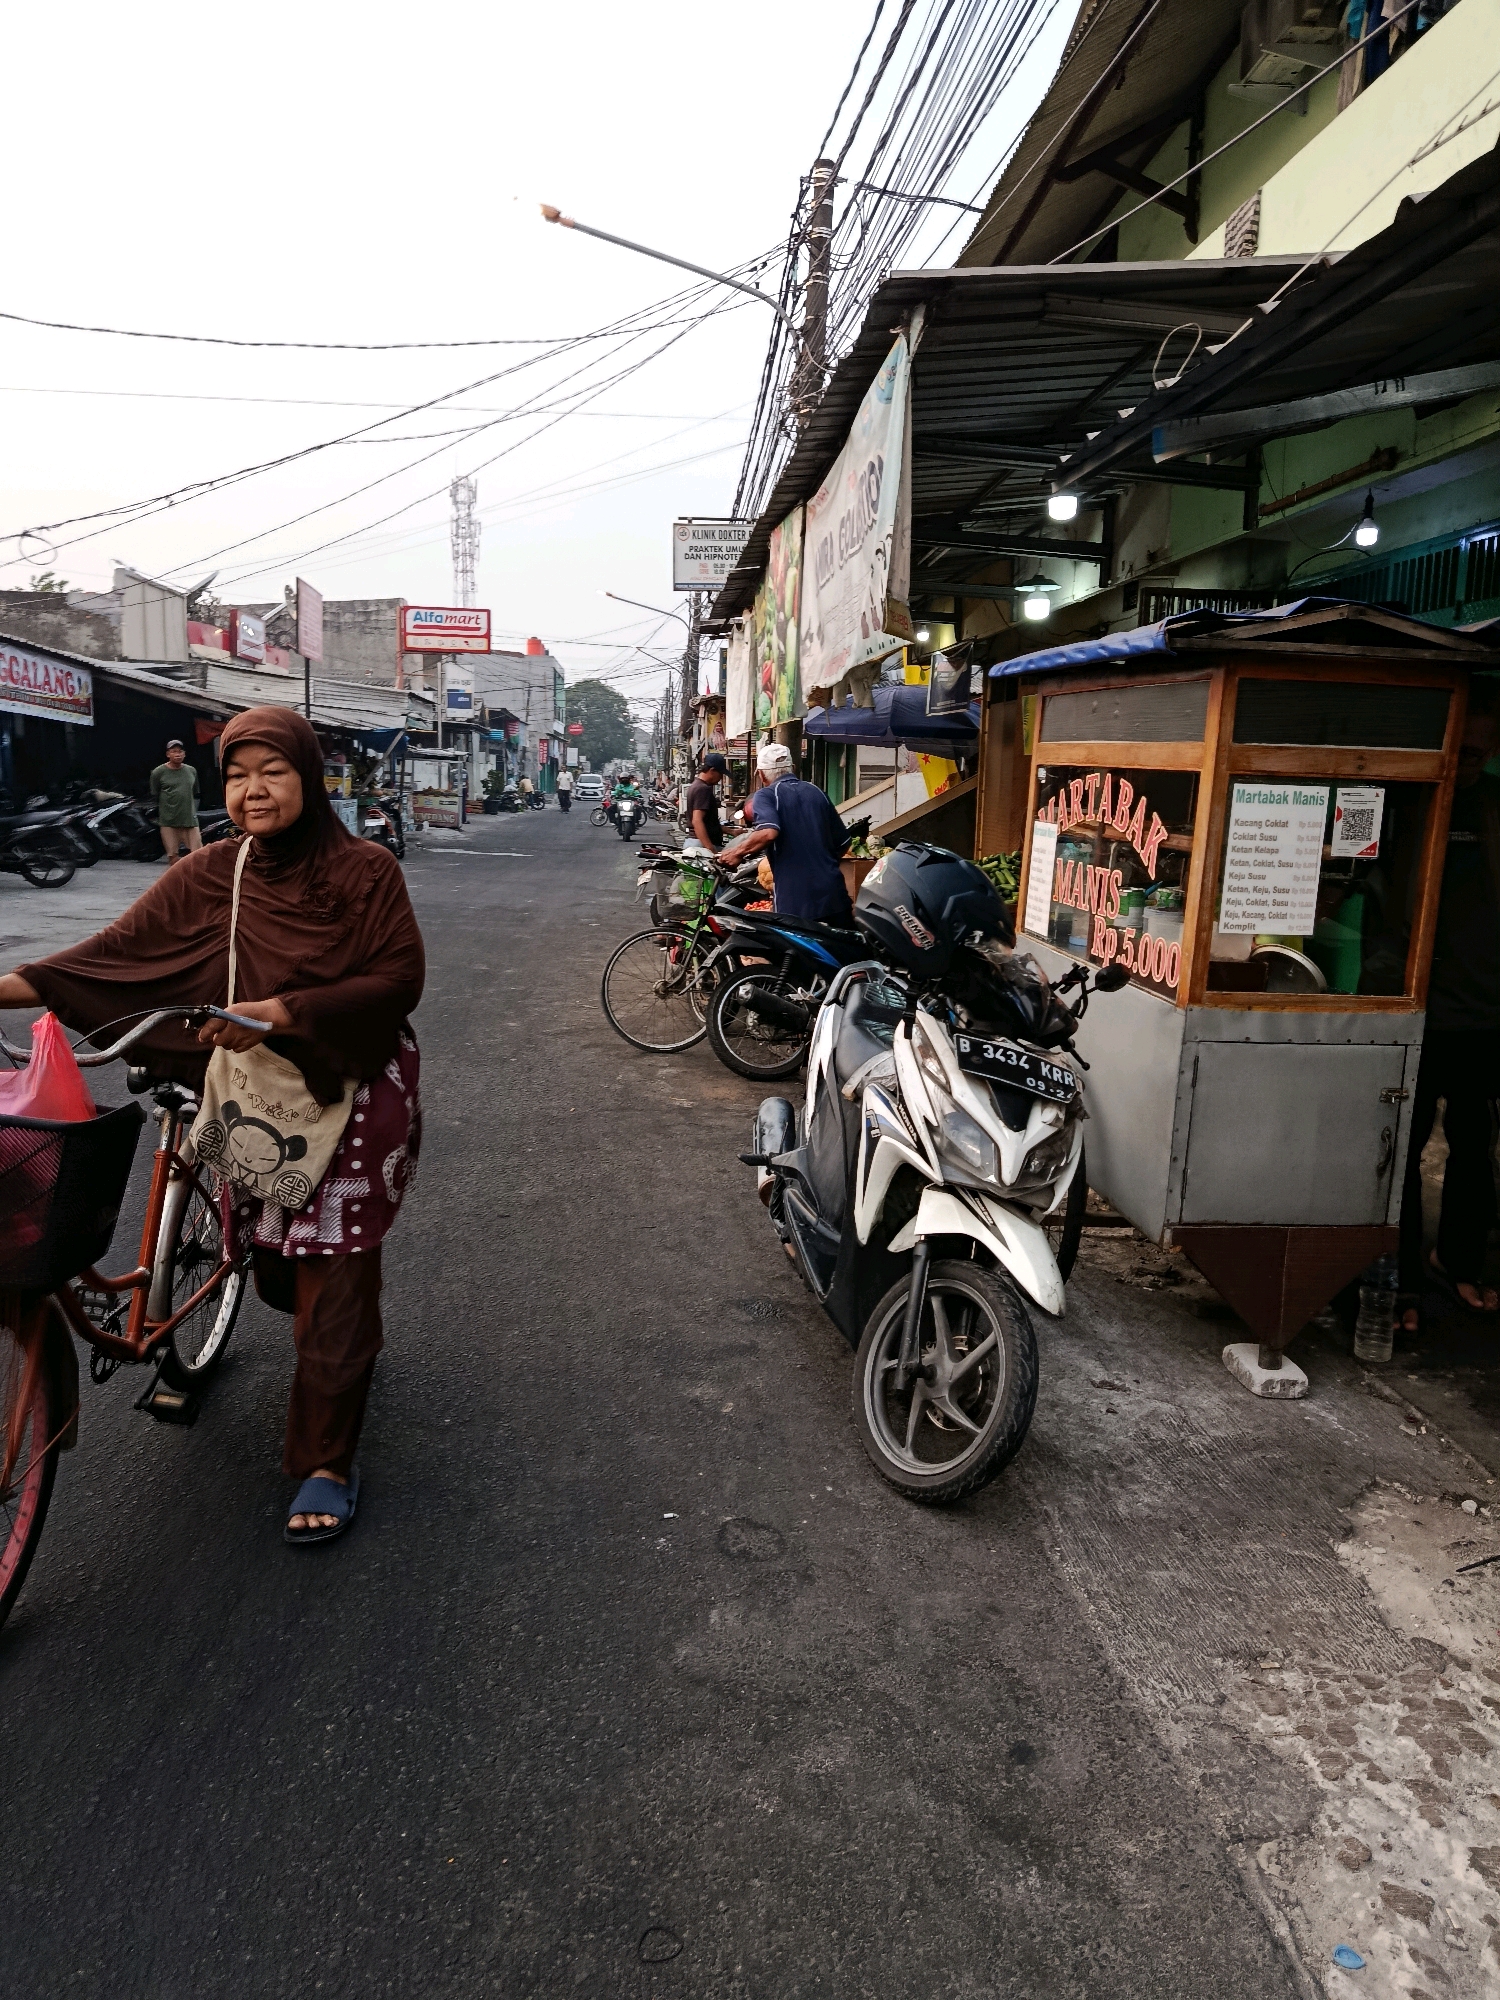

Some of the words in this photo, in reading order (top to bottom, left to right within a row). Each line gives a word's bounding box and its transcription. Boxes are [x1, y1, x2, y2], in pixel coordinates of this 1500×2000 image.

[692, 530, 716, 540] KLINIK
[719, 530, 746, 540] DOKTER
[413, 611, 480, 625] Alfamart
[1236, 789, 1289, 804] Martabak
[1293, 791, 1325, 806] Manis
[1234, 818, 1262, 829] Kacang
[1265, 819, 1289, 828] Coklat
[1233, 832, 1257, 840] Coklat
[1259, 833, 1277, 841] Susu
[1231, 845, 1252, 853] Ketan
[1255, 846, 1279, 855] Kelapa
[1230, 859, 1251, 868] Ketan,
[1253, 860, 1275, 869] Coklat,
[1278, 860, 1293, 868] Susu
[1229, 872, 1245, 881] Keju
[1053, 857, 1122, 919] MANIS
[1227, 885, 1250, 894] Ketan,
[1253, 886, 1271, 895] Keju,
[1226, 898, 1243, 907] Keju,
[1246, 899, 1269, 907] Coklat,
[1272, 899, 1288, 907] Susu
[897, 905, 934, 950] PREMIER
[1223, 922, 1256, 931] Komplit
[959, 1038, 971, 1052] B
[982, 1044, 1030, 1070] 3434
[1041, 1061, 1074, 1087] KRR
